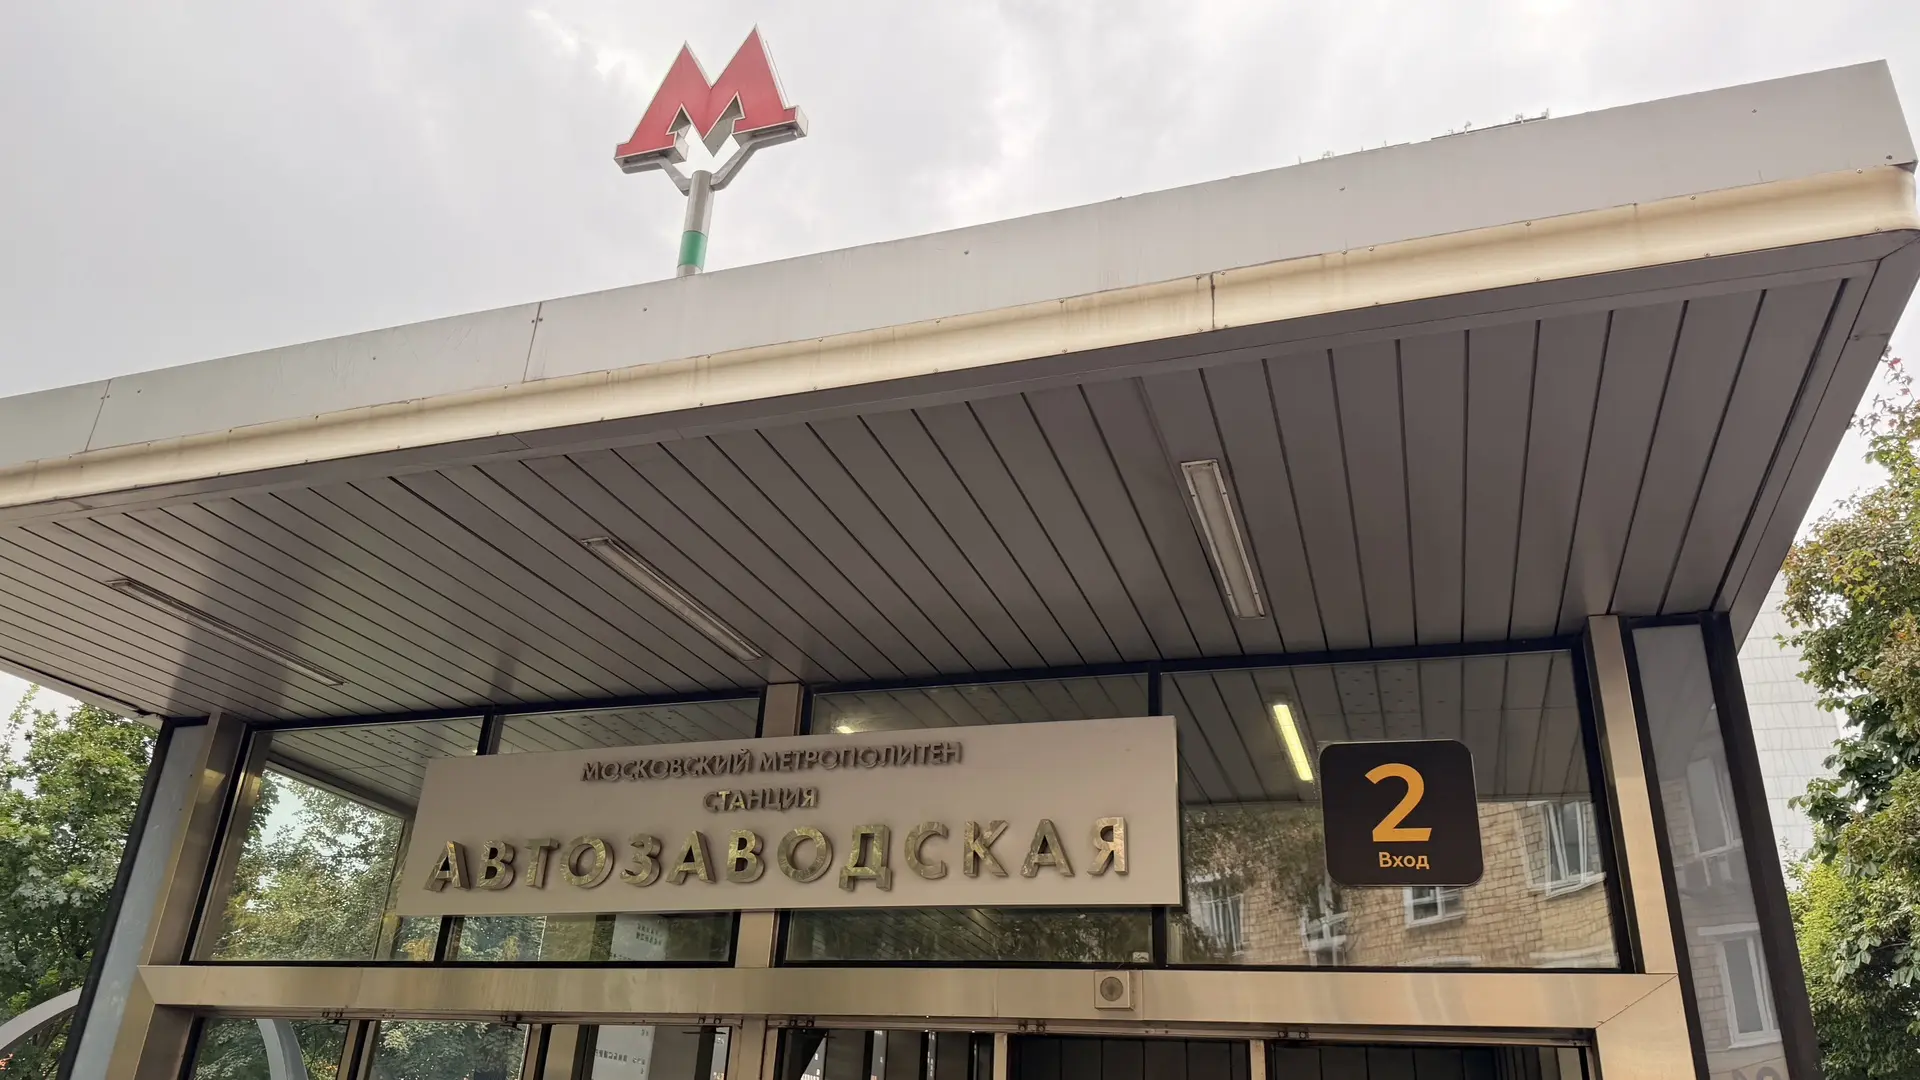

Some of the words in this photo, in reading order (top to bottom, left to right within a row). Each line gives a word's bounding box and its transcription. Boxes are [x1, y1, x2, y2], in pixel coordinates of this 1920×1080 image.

[614, 23, 808, 162] М
[582, 748, 753, 782] МОСКОВСКИЙ
[759, 741, 963, 771] МЕТРОПОЛИТЕН
[703, 786, 819, 813] СТАНЦИЯ
[1364, 763, 1432, 841] 2
[424, 817, 1129, 892] АВТОЗАВОДСКАЯ
[1378, 851, 1430, 870] Вход
